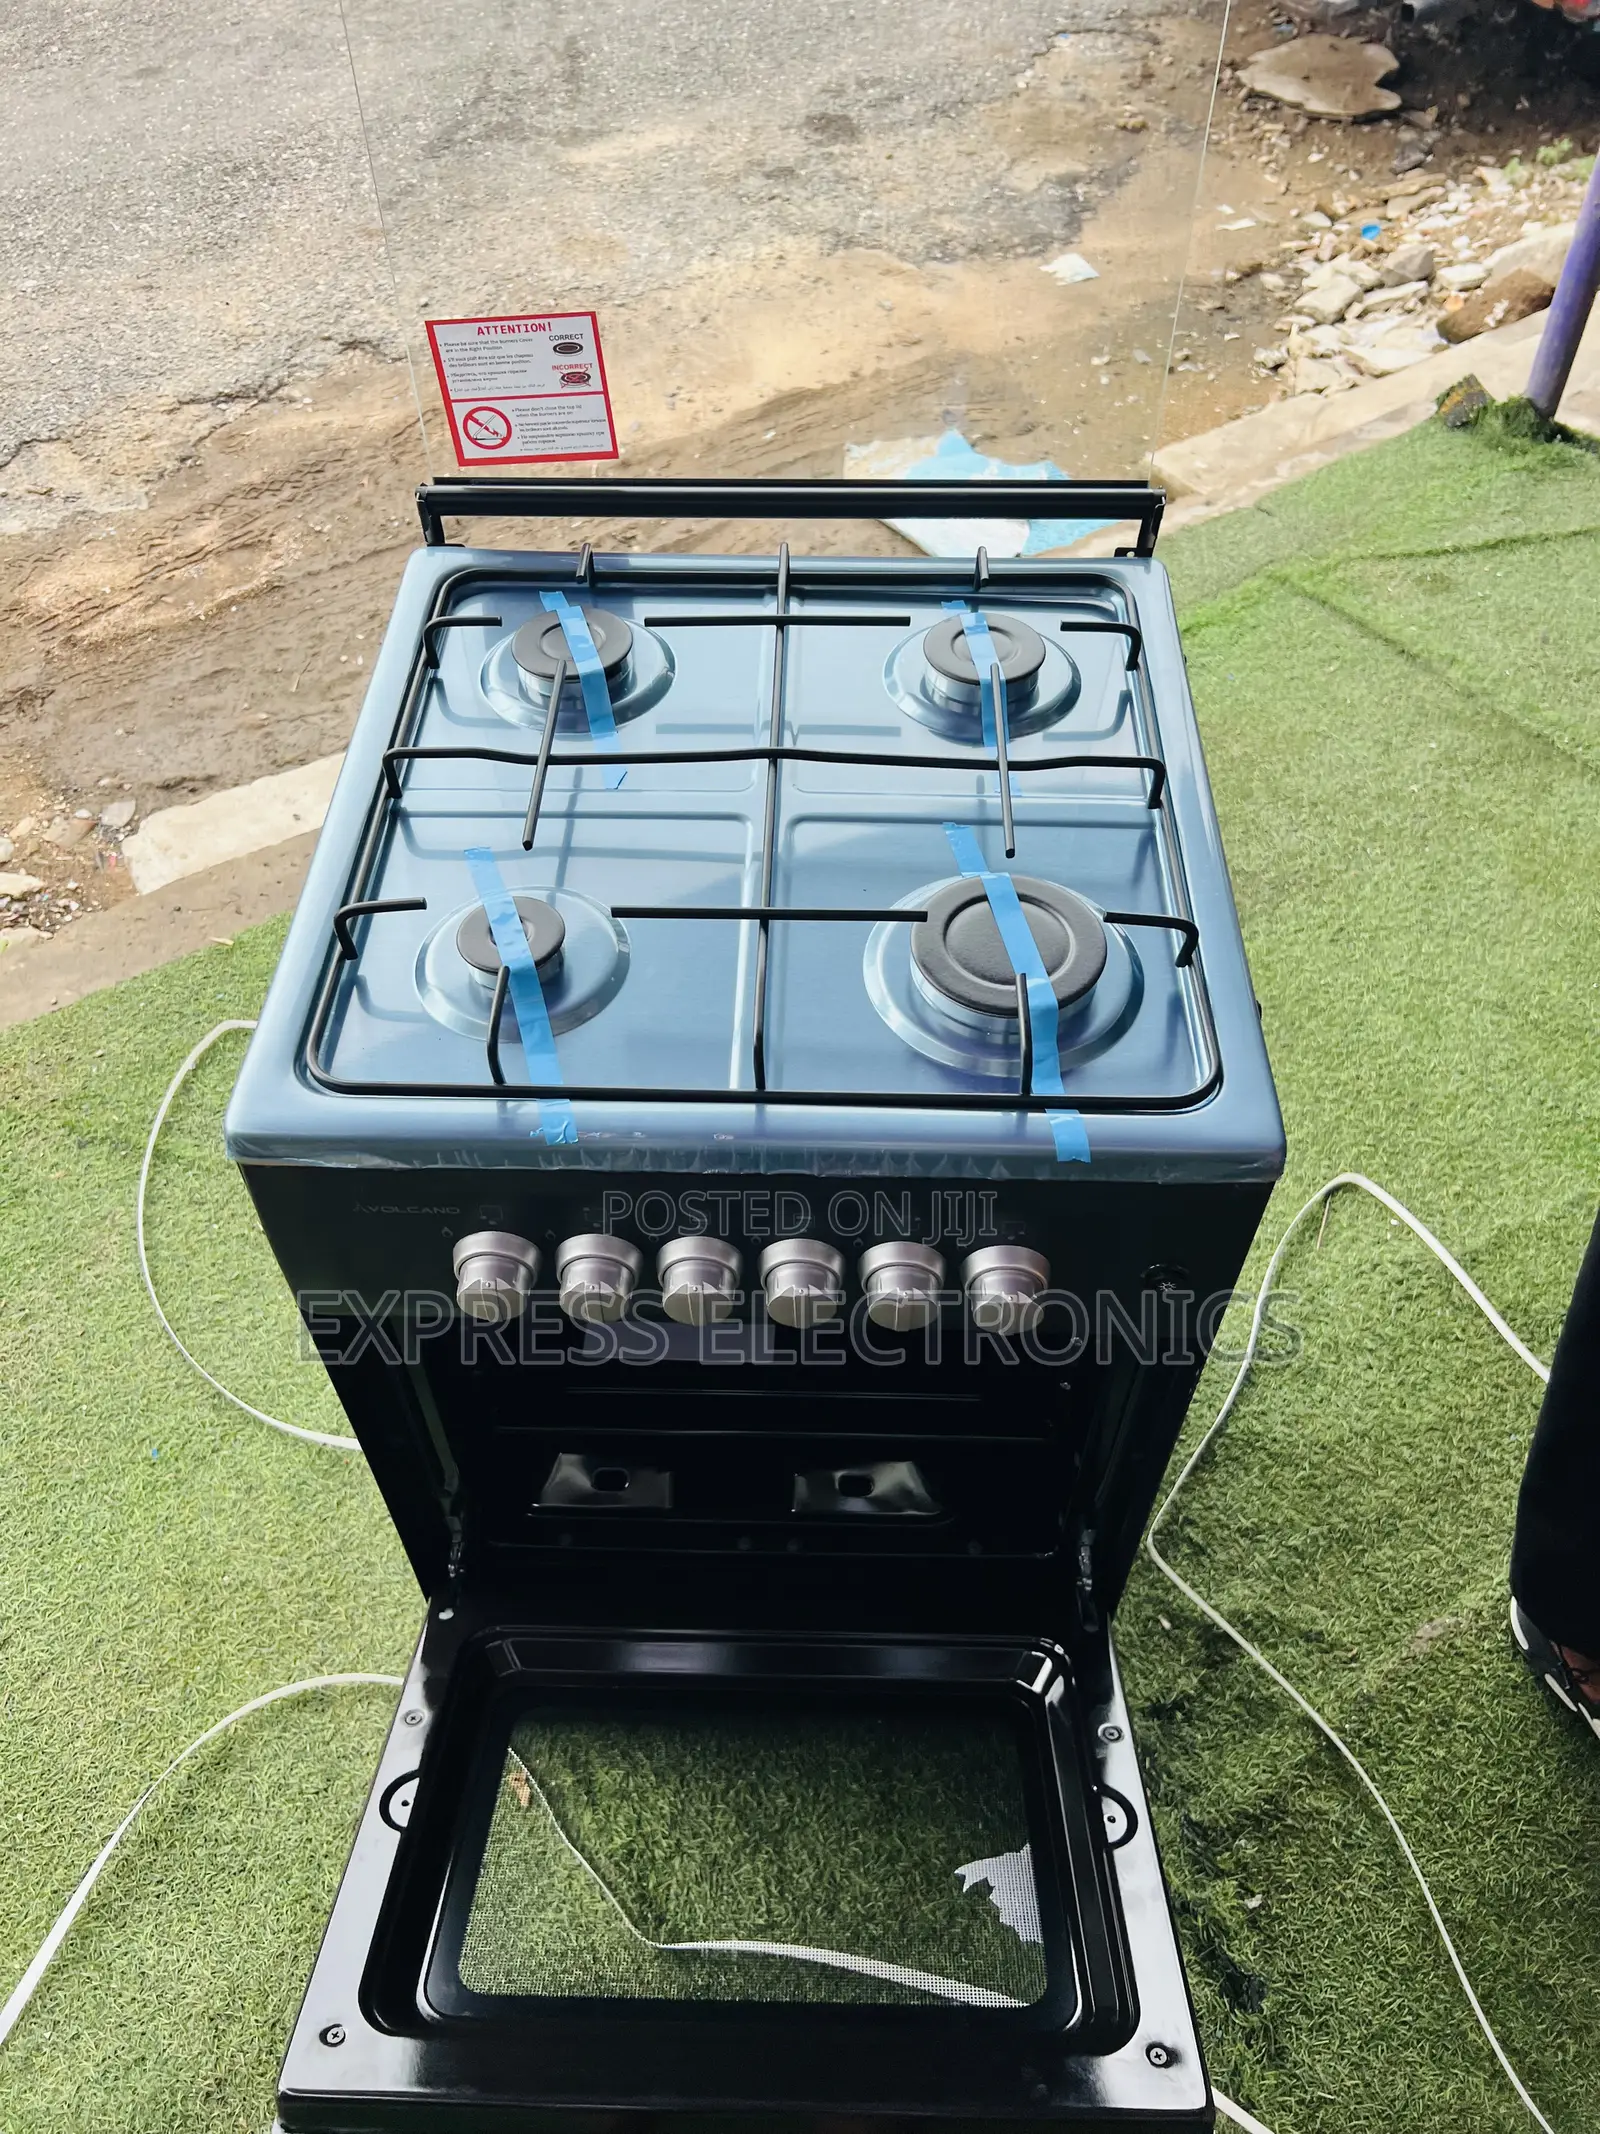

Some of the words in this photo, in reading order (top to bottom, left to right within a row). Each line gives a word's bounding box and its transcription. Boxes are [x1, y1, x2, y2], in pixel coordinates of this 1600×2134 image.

[476, 322, 552, 336] ATTENTION!
[552, 363, 592, 371] INCORRECT
[366, 1204, 460, 1214] VOLCANO
